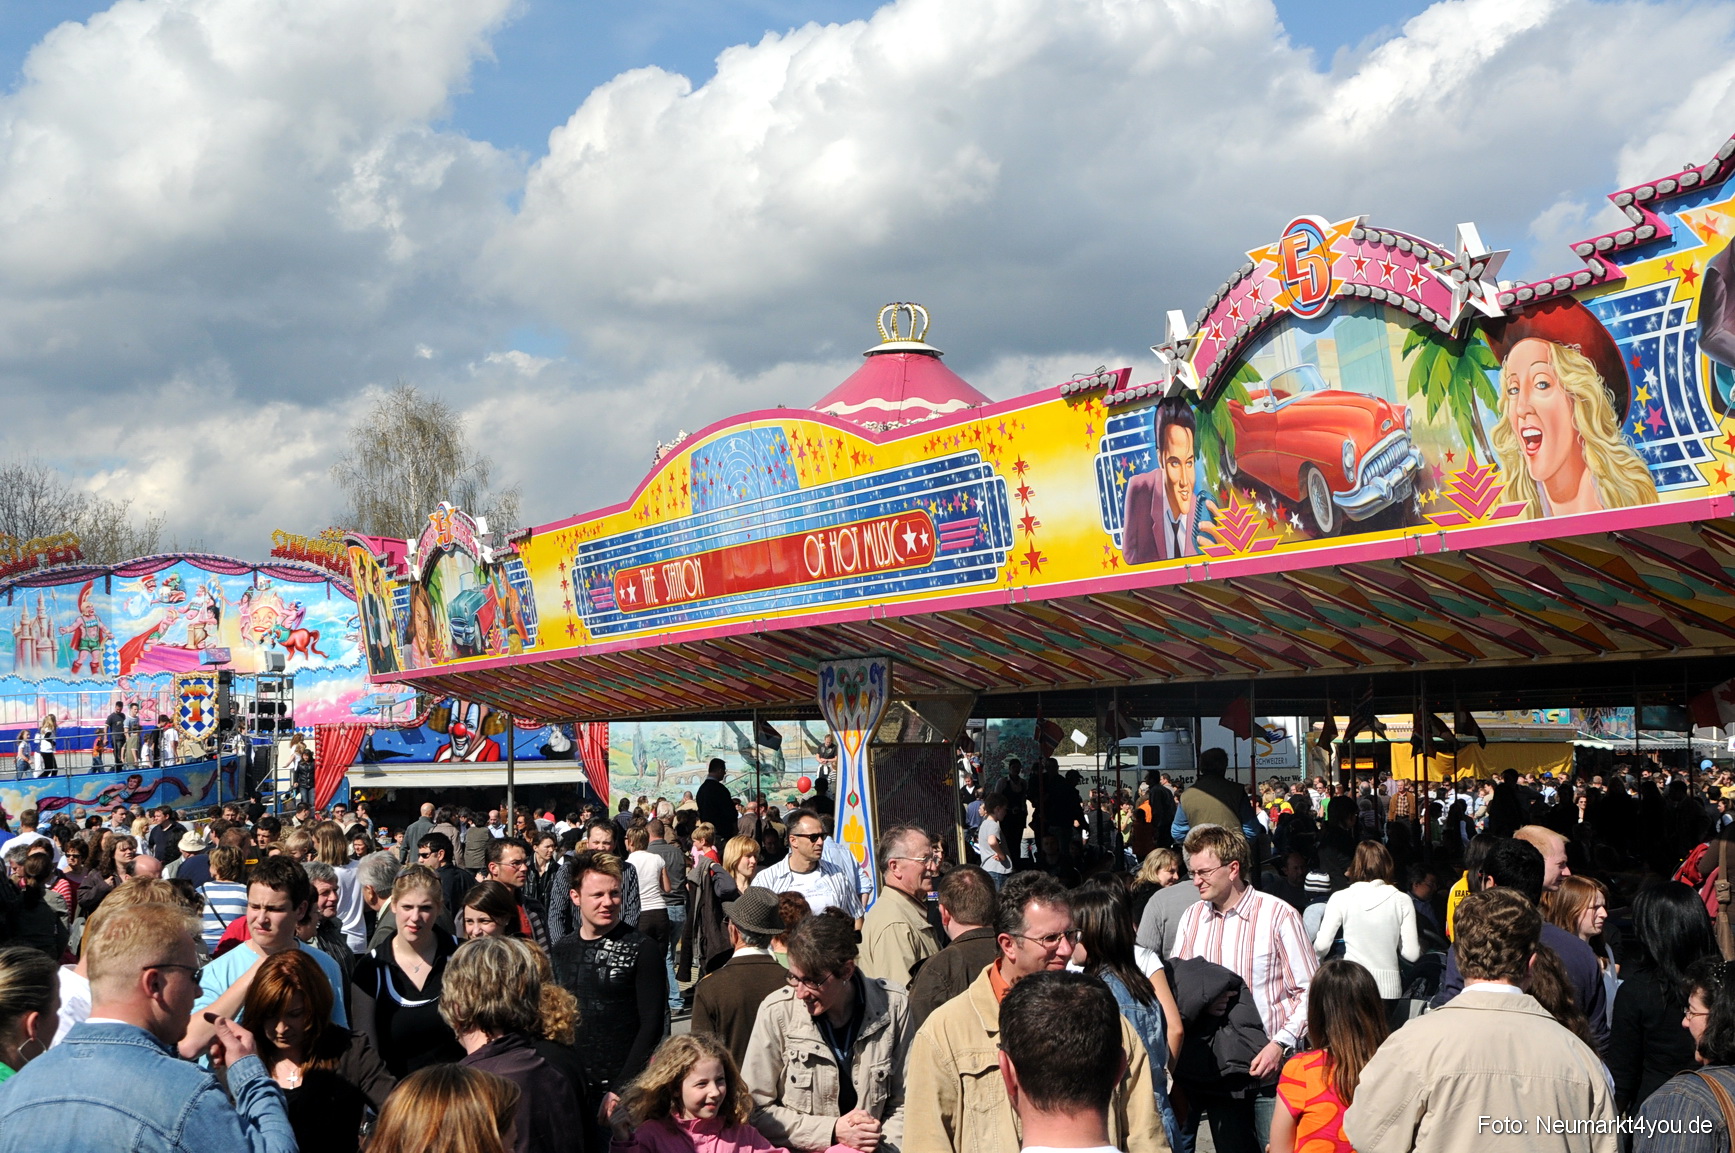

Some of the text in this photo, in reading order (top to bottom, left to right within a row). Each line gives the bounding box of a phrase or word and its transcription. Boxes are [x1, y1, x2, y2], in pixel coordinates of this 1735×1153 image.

[640, 519, 905, 606] THE STATION OF HOT MUSIC
[183, 684, 209, 697] NR
[188, 699, 203, 722] 1
